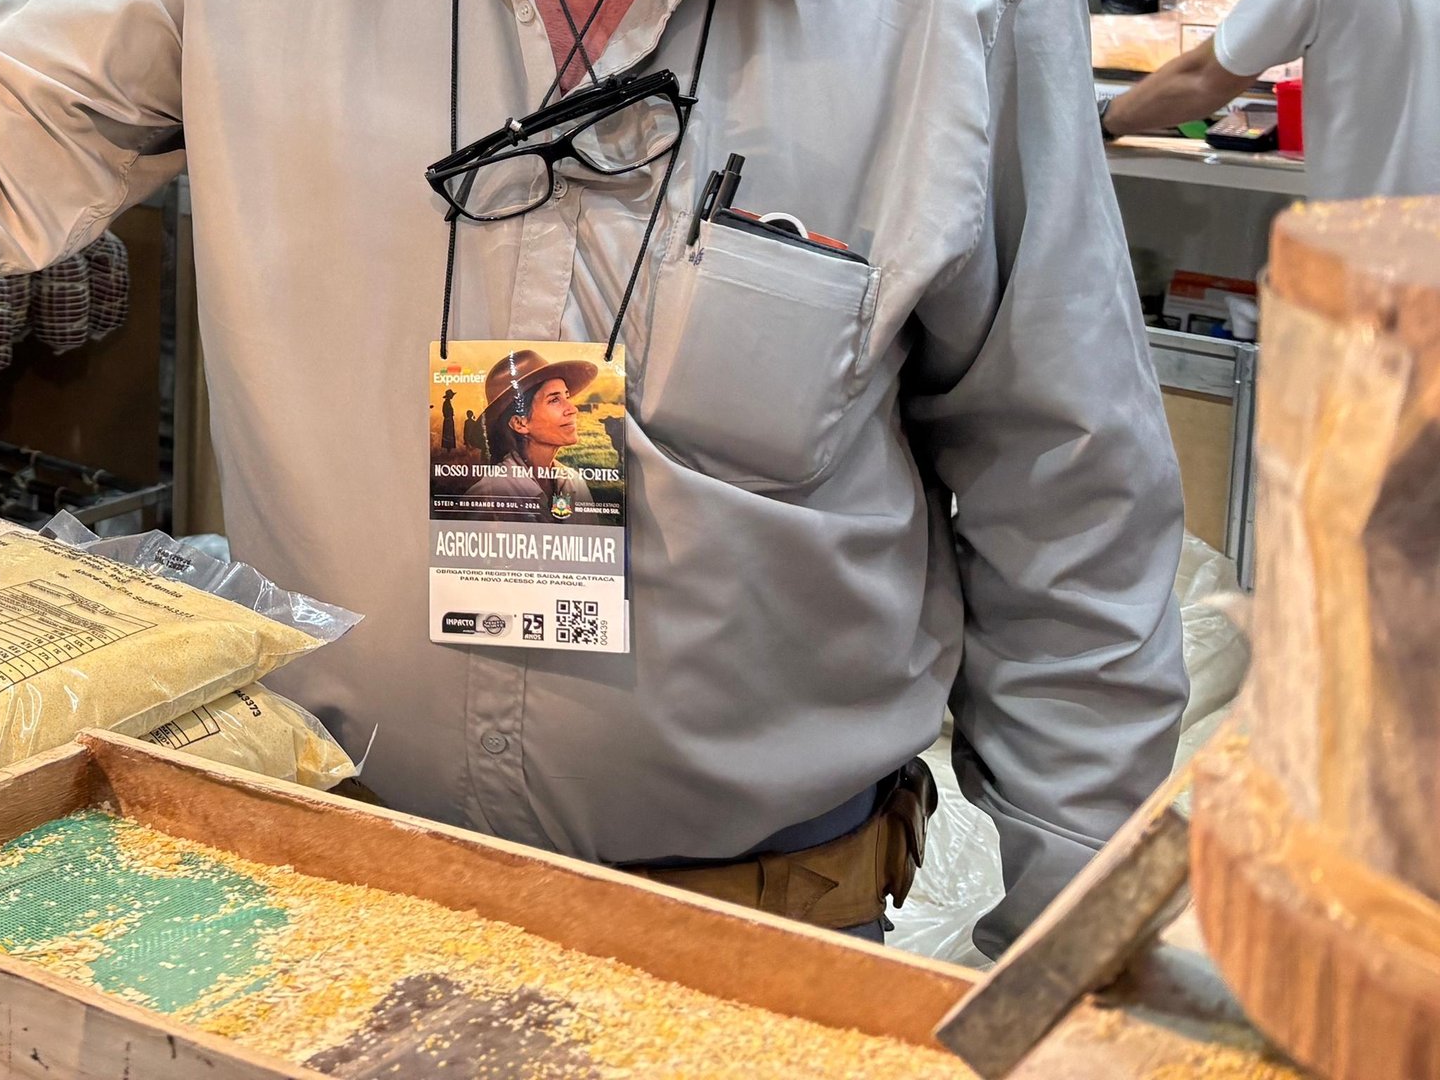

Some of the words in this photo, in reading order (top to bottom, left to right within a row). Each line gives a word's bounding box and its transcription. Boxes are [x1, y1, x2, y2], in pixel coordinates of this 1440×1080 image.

[433, 372, 486, 386] Expointer
[434, 464, 468, 477] NOSSO
[472, 464, 507, 478] FUTURO
[511, 465, 533, 479] TEM
[579, 468, 619, 481] FORTES
[436, 531, 538, 560] AGRICULTURA
[542, 534, 616, 563] FAMILIAR
[446, 618, 475, 627] IMPACTO
[600, 620, 608, 645] 00439
